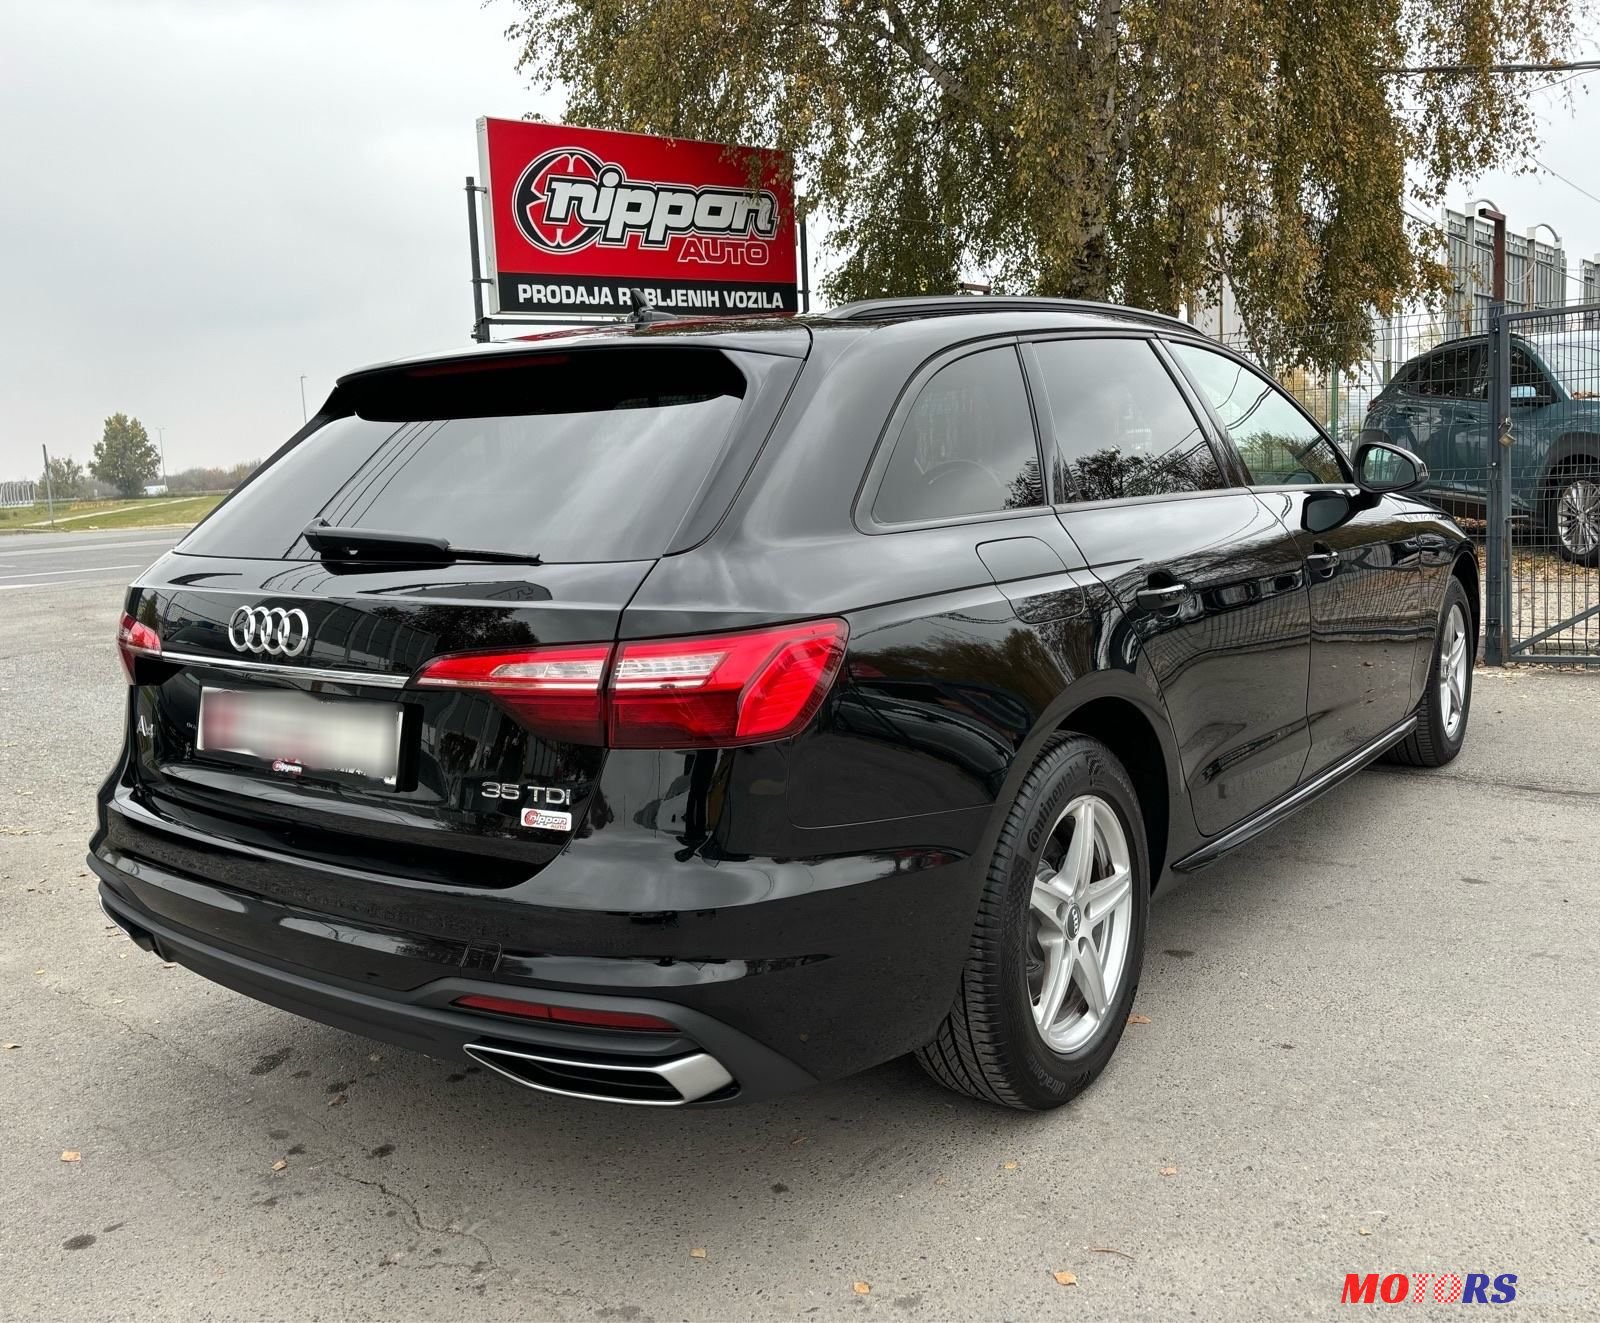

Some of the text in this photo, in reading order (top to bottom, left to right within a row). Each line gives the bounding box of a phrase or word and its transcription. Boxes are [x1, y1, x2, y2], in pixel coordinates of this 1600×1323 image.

[545, 166, 777, 246] nippon
[677, 238, 769, 265] AUTO
[517, 284, 783, 309] PRODAJA RBLJENIH VOZILA
[481, 781, 571, 805] 35 TDI
[529, 813, 568, 826] nippon
